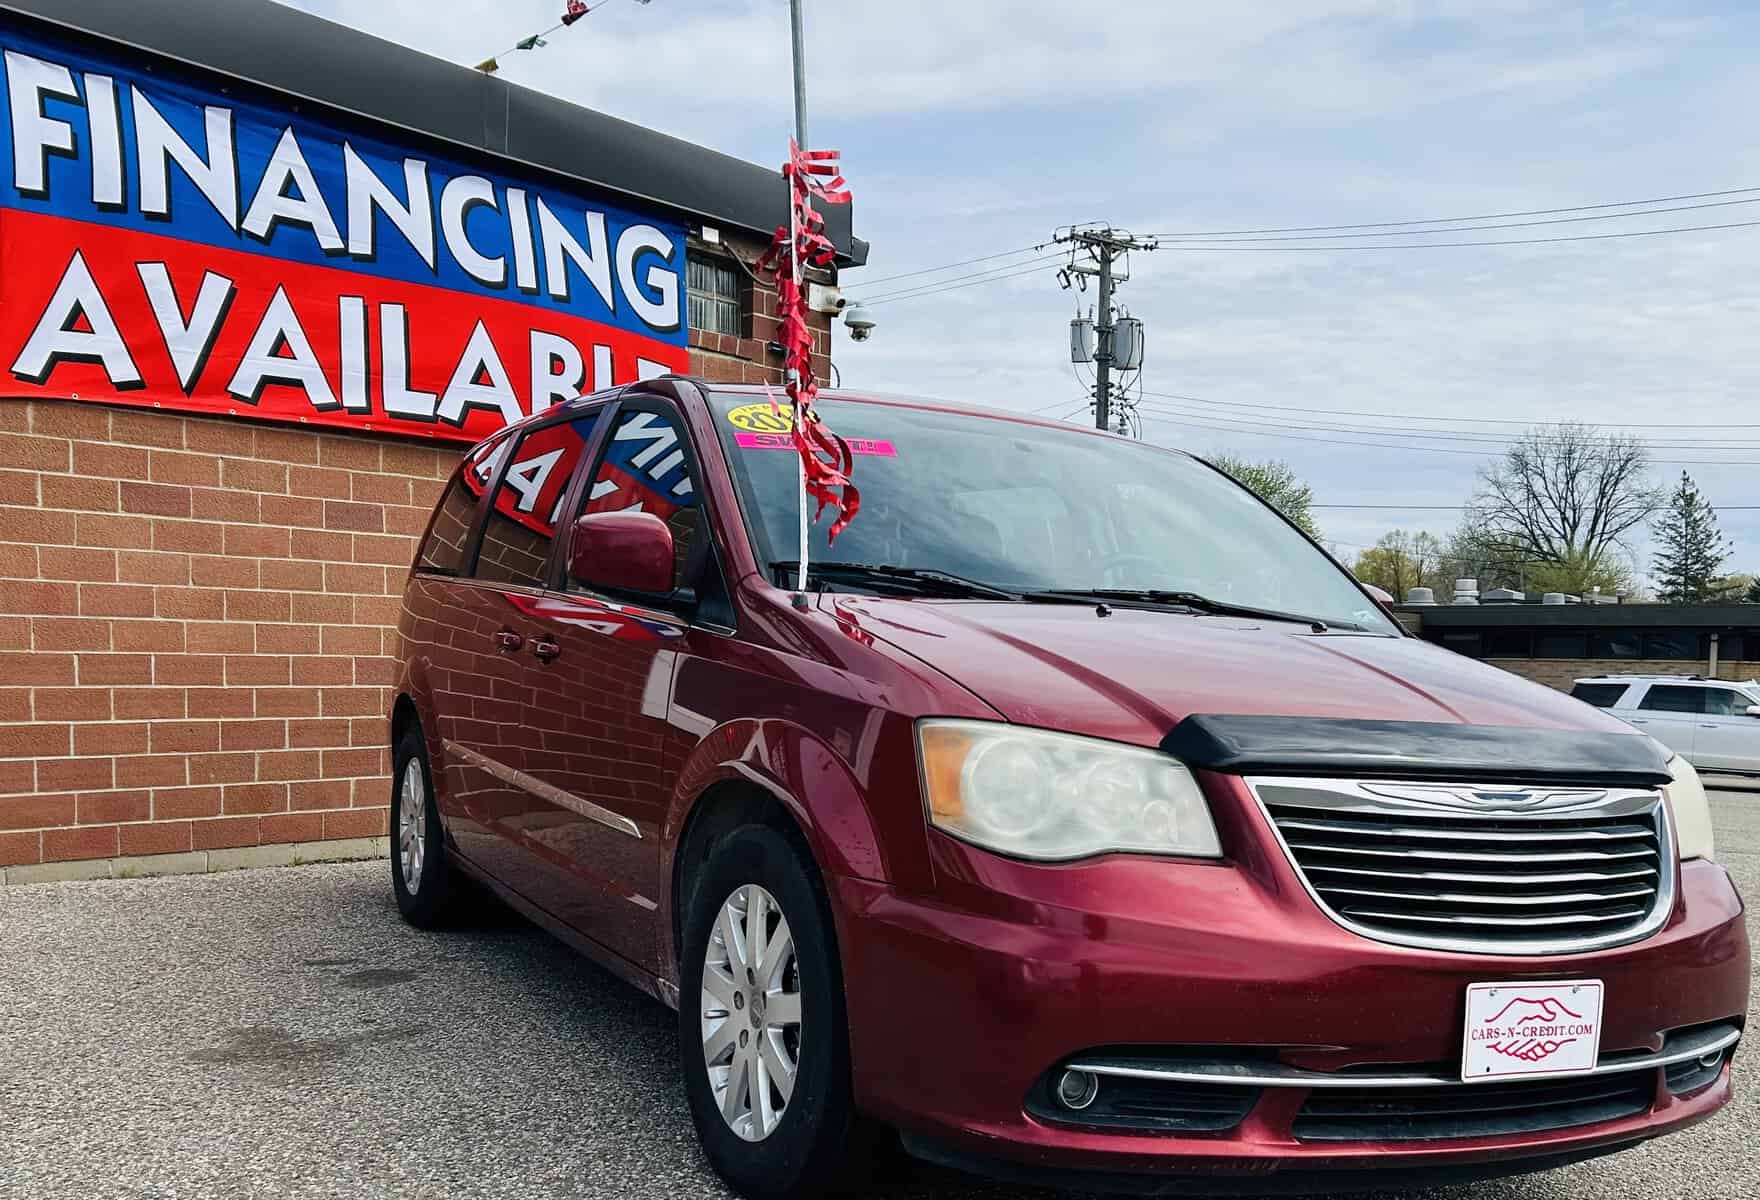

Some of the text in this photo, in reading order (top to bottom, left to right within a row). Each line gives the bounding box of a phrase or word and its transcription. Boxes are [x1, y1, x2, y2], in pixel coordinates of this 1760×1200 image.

[4, 49, 682, 331] FINANCING
[11, 248, 672, 424] AVAILAB
[1471, 1023, 1593, 1041] CARS-N-CREDIT.COM
